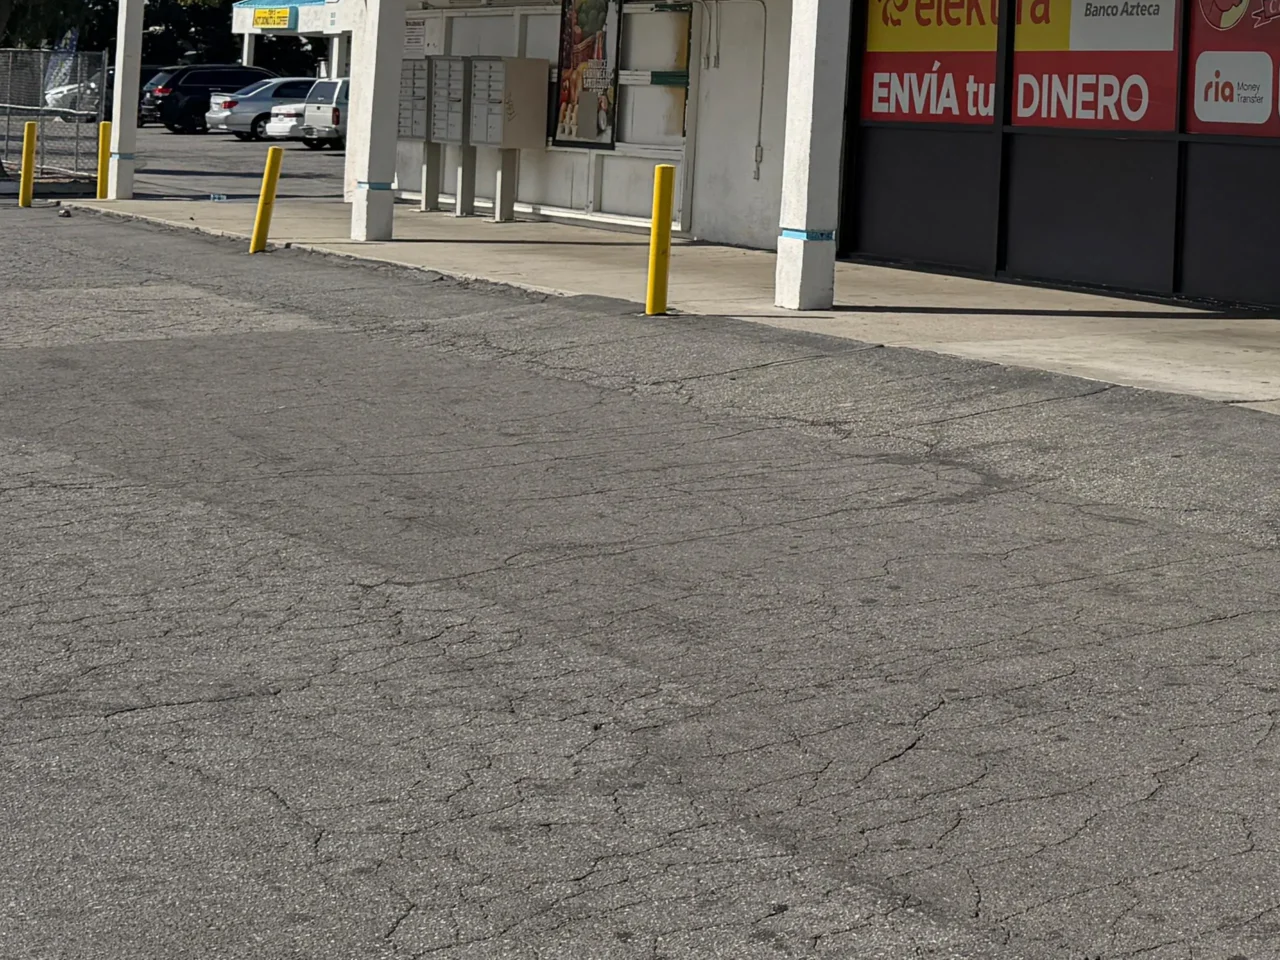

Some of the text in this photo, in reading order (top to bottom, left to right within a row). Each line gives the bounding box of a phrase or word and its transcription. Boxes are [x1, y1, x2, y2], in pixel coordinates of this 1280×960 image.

[1085, 1, 1160, 17] Banco Azteca
[872, 60, 1149, 122] ENVÍA tu DINERO
[1204, 69, 1234, 103] ria
[1237, 82, 1260, 93] Money
[1237, 93, 1264, 104] Transfer
